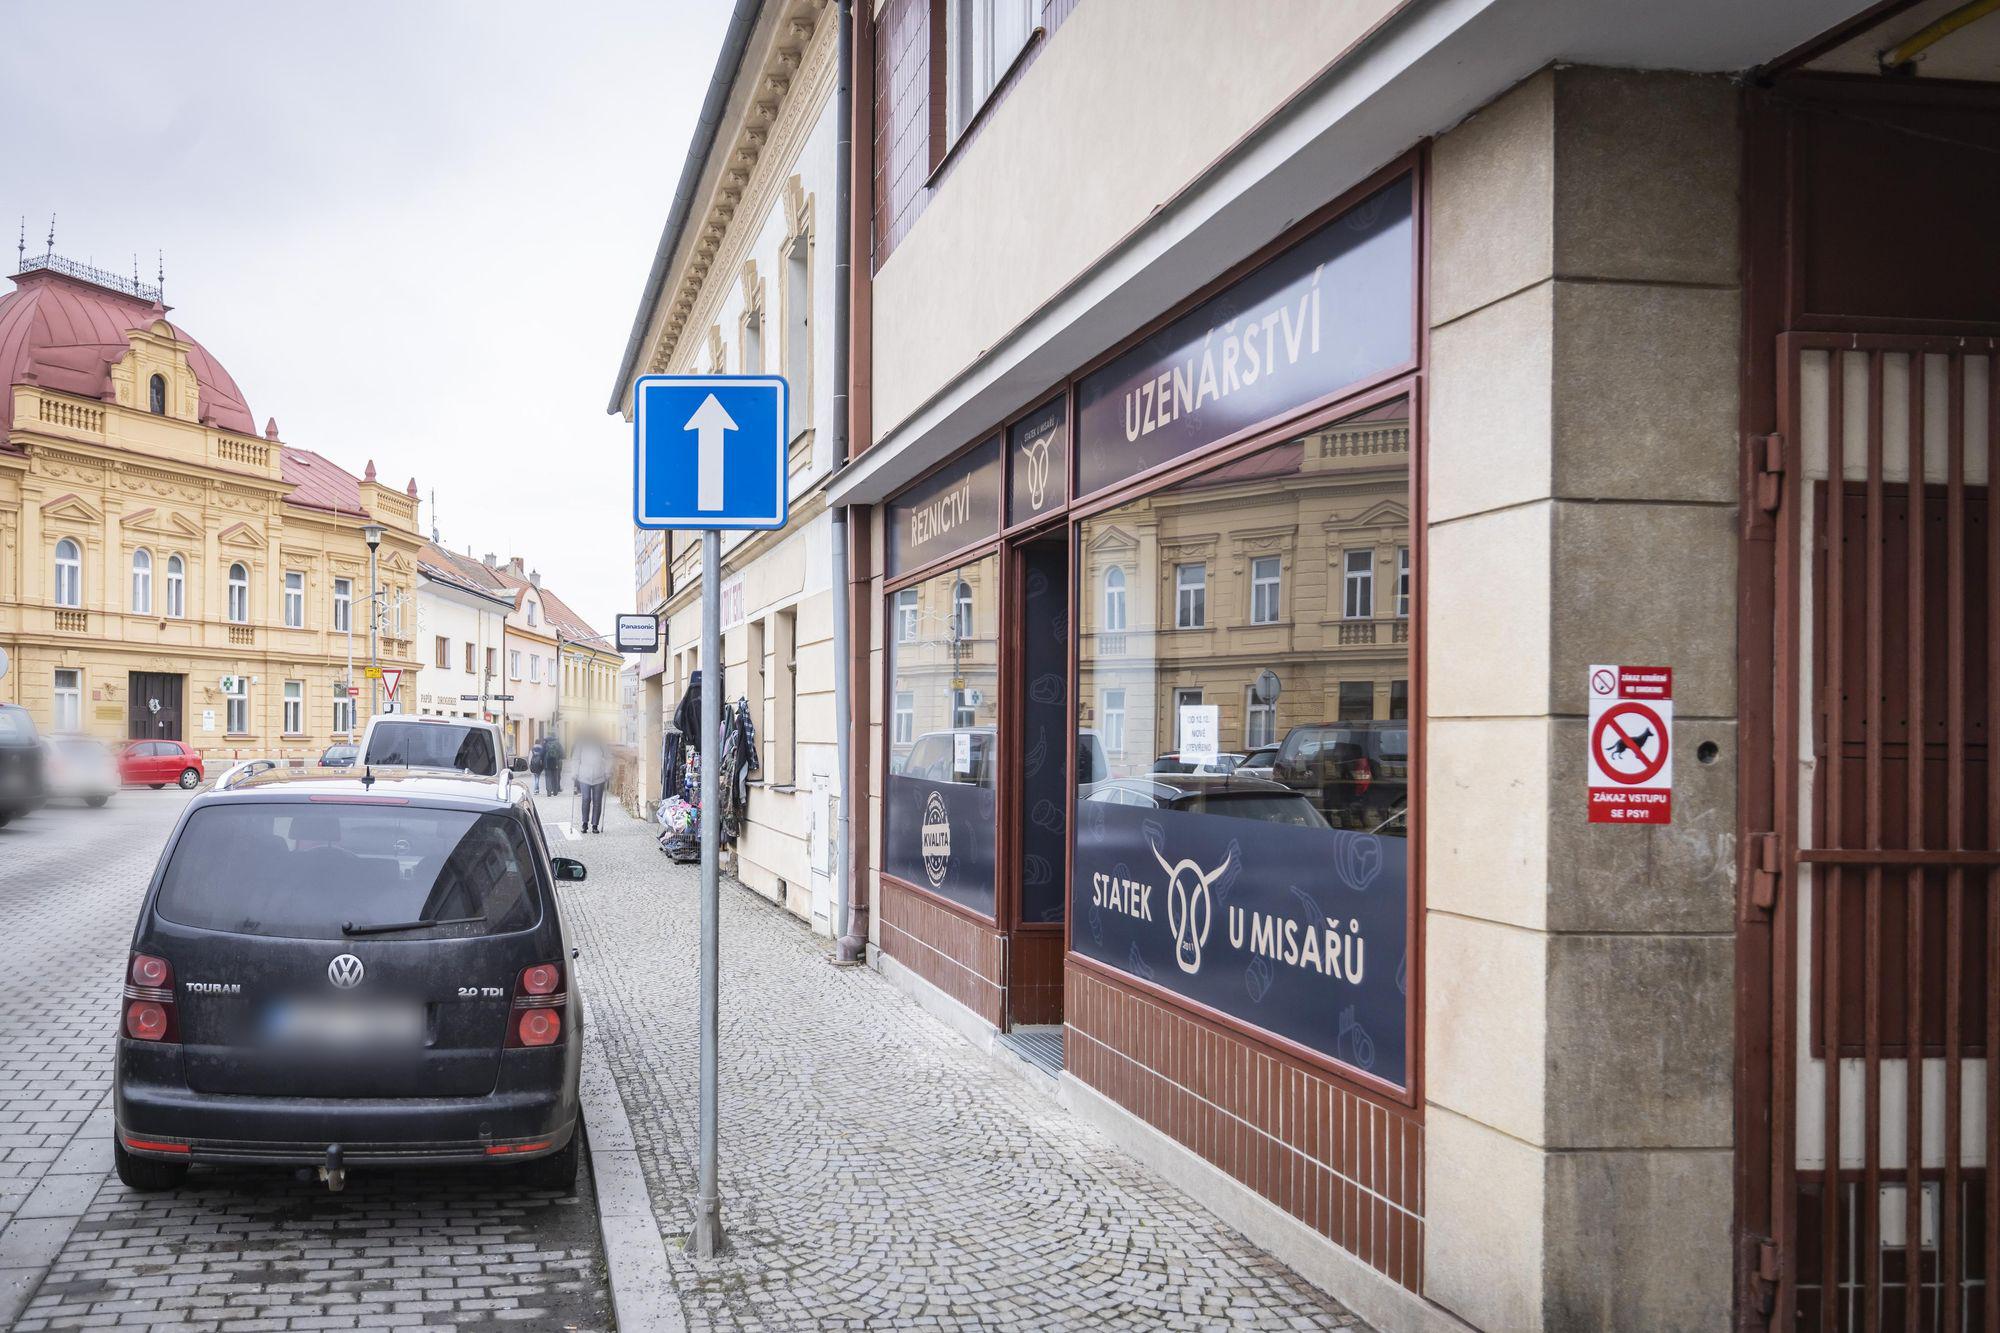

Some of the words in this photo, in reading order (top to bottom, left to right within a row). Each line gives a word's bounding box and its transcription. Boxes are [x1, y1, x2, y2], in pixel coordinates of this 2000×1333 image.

[1125, 262, 1326, 442] UZENÁŘSTVÍ
[911, 472, 971, 548] ŘEZNICTVÍ
[1593, 792, 1625, 802] ZÁKAZ
[1628, 793, 1667, 803] VSTUPU
[1611, 809, 1624, 818] SE
[1626, 809, 1649, 819] PSY!
[923, 832, 949, 847] KVALITA
[1092, 871, 1153, 922] STATEK
[1229, 905, 1244, 949] U
[1250, 911, 1365, 985] MISAŘŮ
[186, 982, 241, 994] TOURAN
[481, 987, 504, 996] TDI
